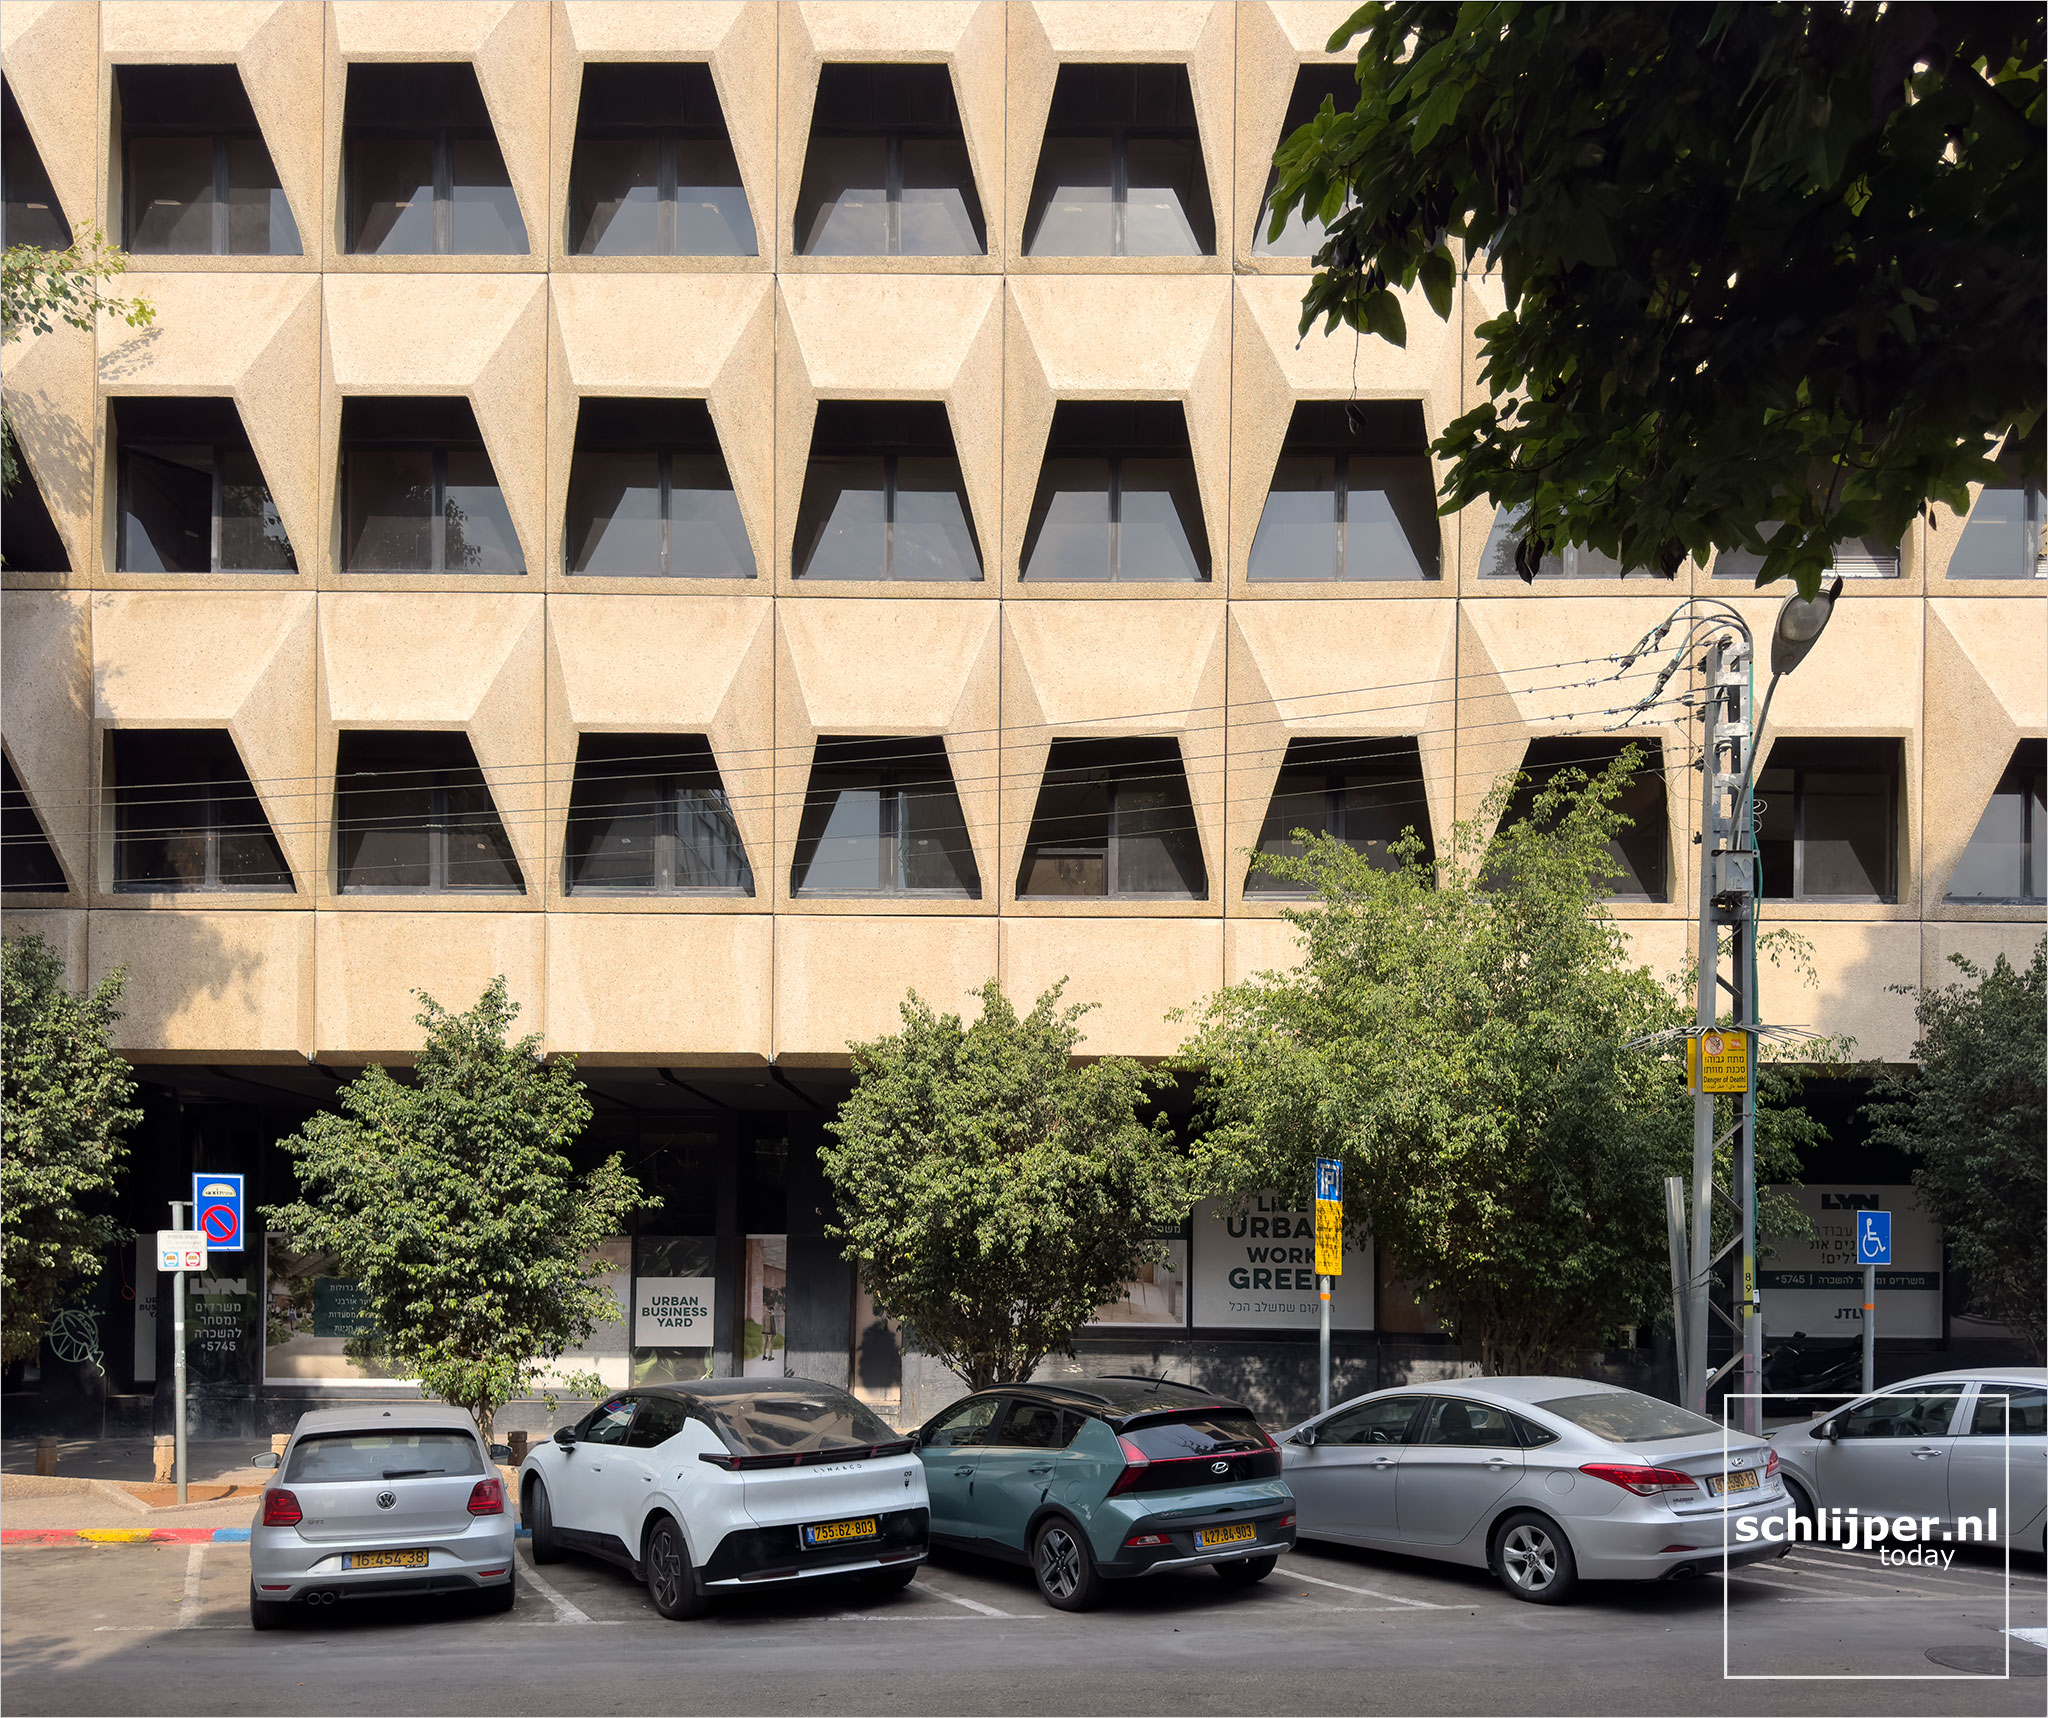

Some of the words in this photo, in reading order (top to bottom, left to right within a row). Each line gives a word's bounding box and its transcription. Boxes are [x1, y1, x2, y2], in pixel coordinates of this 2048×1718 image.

[1727, 1055, 1745, 1064] מתח
[1726, 1066, 1746, 1074] סכנת
[1703, 1075, 1721, 1085] Danger
[1722, 1075, 1729, 1083] of
[1257, 1196, 1308, 1213] LIE
[1821, 1193, 1880, 1210] LYN
[1226, 1216, 1316, 1239] URBA
[1228, 1267, 1336, 1291] GREE
[1817, 1276, 1857, 1286] להשכרה
[1889, 1276, 1926, 1286] משרדים
[189, 1278, 248, 1295] LYN
[651, 1296, 699, 1306] URBAN
[195, 1303, 242, 1313] משרדים
[641, 1307, 708, 1317] BUSINESS
[1228, 1301, 1250, 1313] הכל
[1254, 1301, 1296, 1313] שמשלב
[199, 1316, 237, 1326] ומסחר
[657, 1318, 693, 1327] YARD
[194, 1328, 242, 1339] להשכרה
